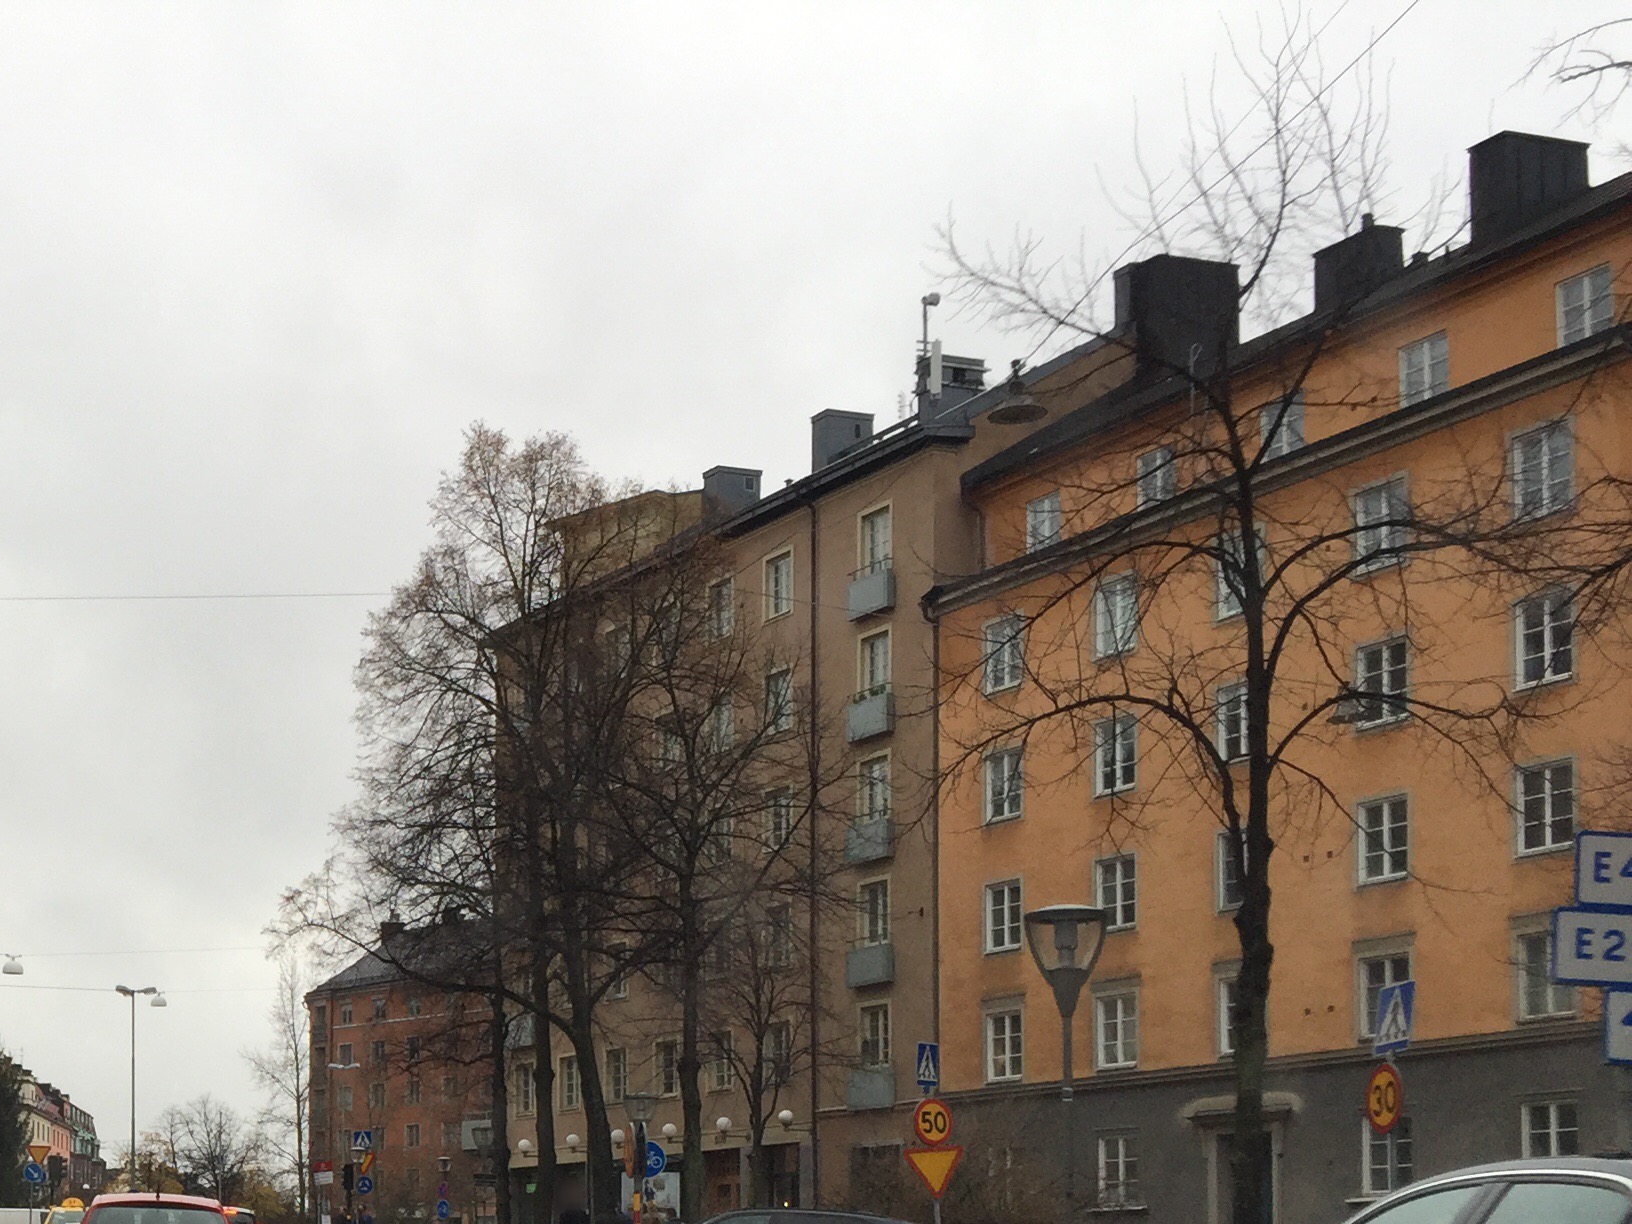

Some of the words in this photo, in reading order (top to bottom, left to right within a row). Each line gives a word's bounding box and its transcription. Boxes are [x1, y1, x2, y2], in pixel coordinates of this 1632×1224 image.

[1574, 927, 1626, 962] E2
[1372, 1080, 1396, 1117] 30
[921, 1111, 947, 1134] 50
